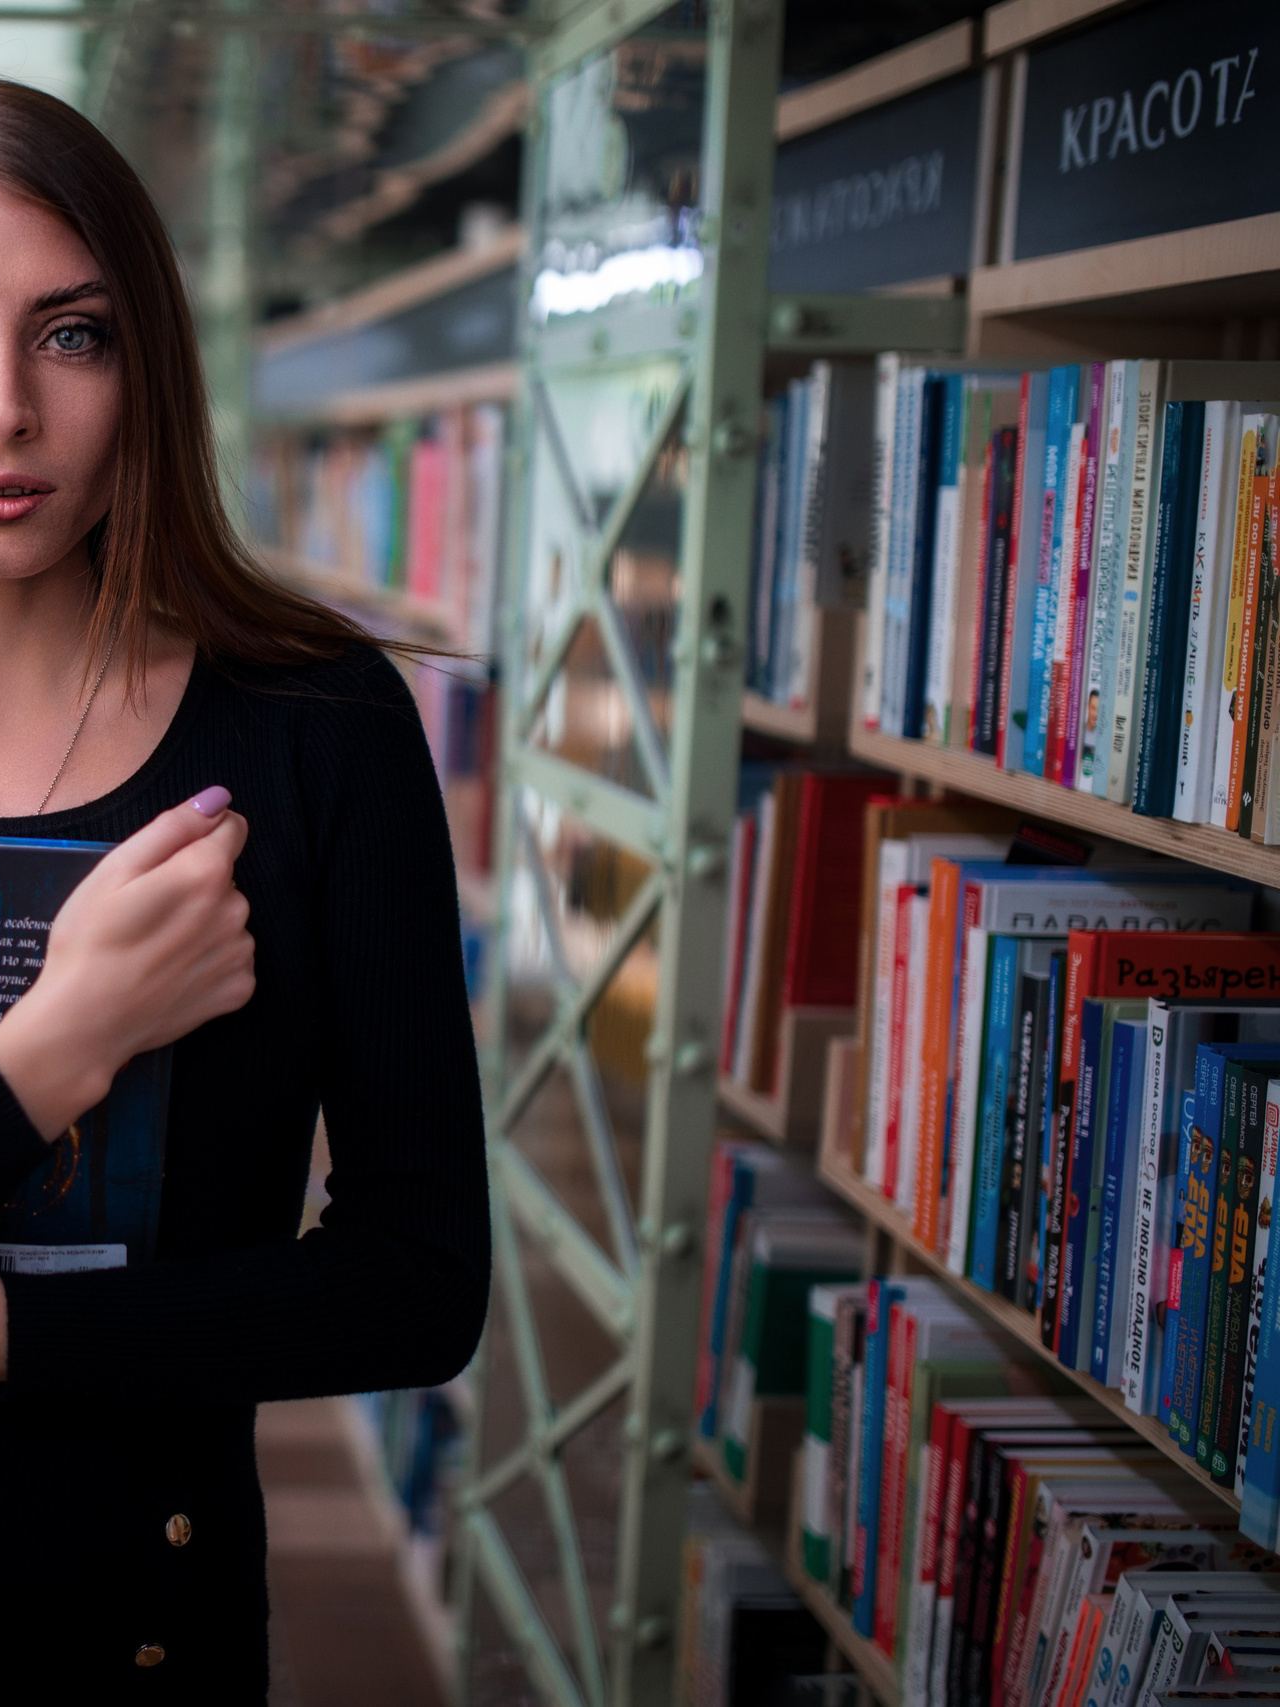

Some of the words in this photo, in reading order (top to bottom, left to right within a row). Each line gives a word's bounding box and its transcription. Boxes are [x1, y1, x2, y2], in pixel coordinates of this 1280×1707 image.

[1133, 390, 1151, 481] ЭГОИСТИЧНАЯ
[1203, 427, 1212, 482] МИШЕЛЬ
[1237, 498, 1244, 512] до
[1243, 490, 1251, 544] стволовые
[1252, 494, 1260, 519] ЛЕТ
[1126, 488, 1144, 581] МИТОХОНДРИЯ
[1152, 503, 1164, 571] ЧЕЛОВЕКА
[1195, 532, 1206, 571] КАК
[1233, 514, 1242, 560] здоровья
[1230, 562, 1239, 598] Секрет
[1240, 548, 1248, 596] взрослые
[1246, 548, 1255, 604] МЕНЬШЕ
[1191, 574, 1203, 620] ЖИТЬ
[1244, 608, 1251, 625] НЕ
[1239, 628, 1249, 691] ПРОЖИТЬ
[1254, 765, 1262, 804] Фредерик
[4, 917, 54, 930] особенно
[18, 939, 40, 951] мы,
[2, 956, 20, 966] Но
[22, 958, 46, 968] это
[1017, 1012, 1032, 1114] ПОХУДЕТЬ
[1153, 1051, 1161, 1097] REGINA
[1199, 1056, 1207, 1095] СЕРГЕЙ
[1209, 1065, 1218, 1104] СЕРГЕЙ
[1239, 1082, 1248, 1148] МАЛОЗЁМОВ
[1249, 1084, 1258, 1124] СЕРГЕЙ
[1015, 1118, 1024, 1160] КАК
[1148, 1102, 1158, 1155] DOCTOR
[1269, 1128, 1278, 1175] ХИМИЯ
[1105, 1172, 1117, 1200] НЕ
[1142, 1187, 1152, 1210] НЕ
[1136, 1214, 1151, 1284] ЛЮБЛЮ
[1180, 1316, 1189, 1326] И
[1210, 1278, 1222, 1338] ЖИВАЯ
[1228, 1291, 1242, 1352] ЖИВАЯ
[1129, 1290, 1145, 1373] СЛАДКОЕ
[1190, 1327, 1199, 1337] И
[1209, 1342, 1217, 1354] И
[1172, 1330, 1189, 1406] МЁРТВАЯ
[1182, 1341, 1199, 1418] МЁРТВАЯ
[1226, 1356, 1236, 1368] И
[1201, 1358, 1217, 1434] МЁРТВАЯ
[1217, 1371, 1236, 1448] МЁРТВАЯ
